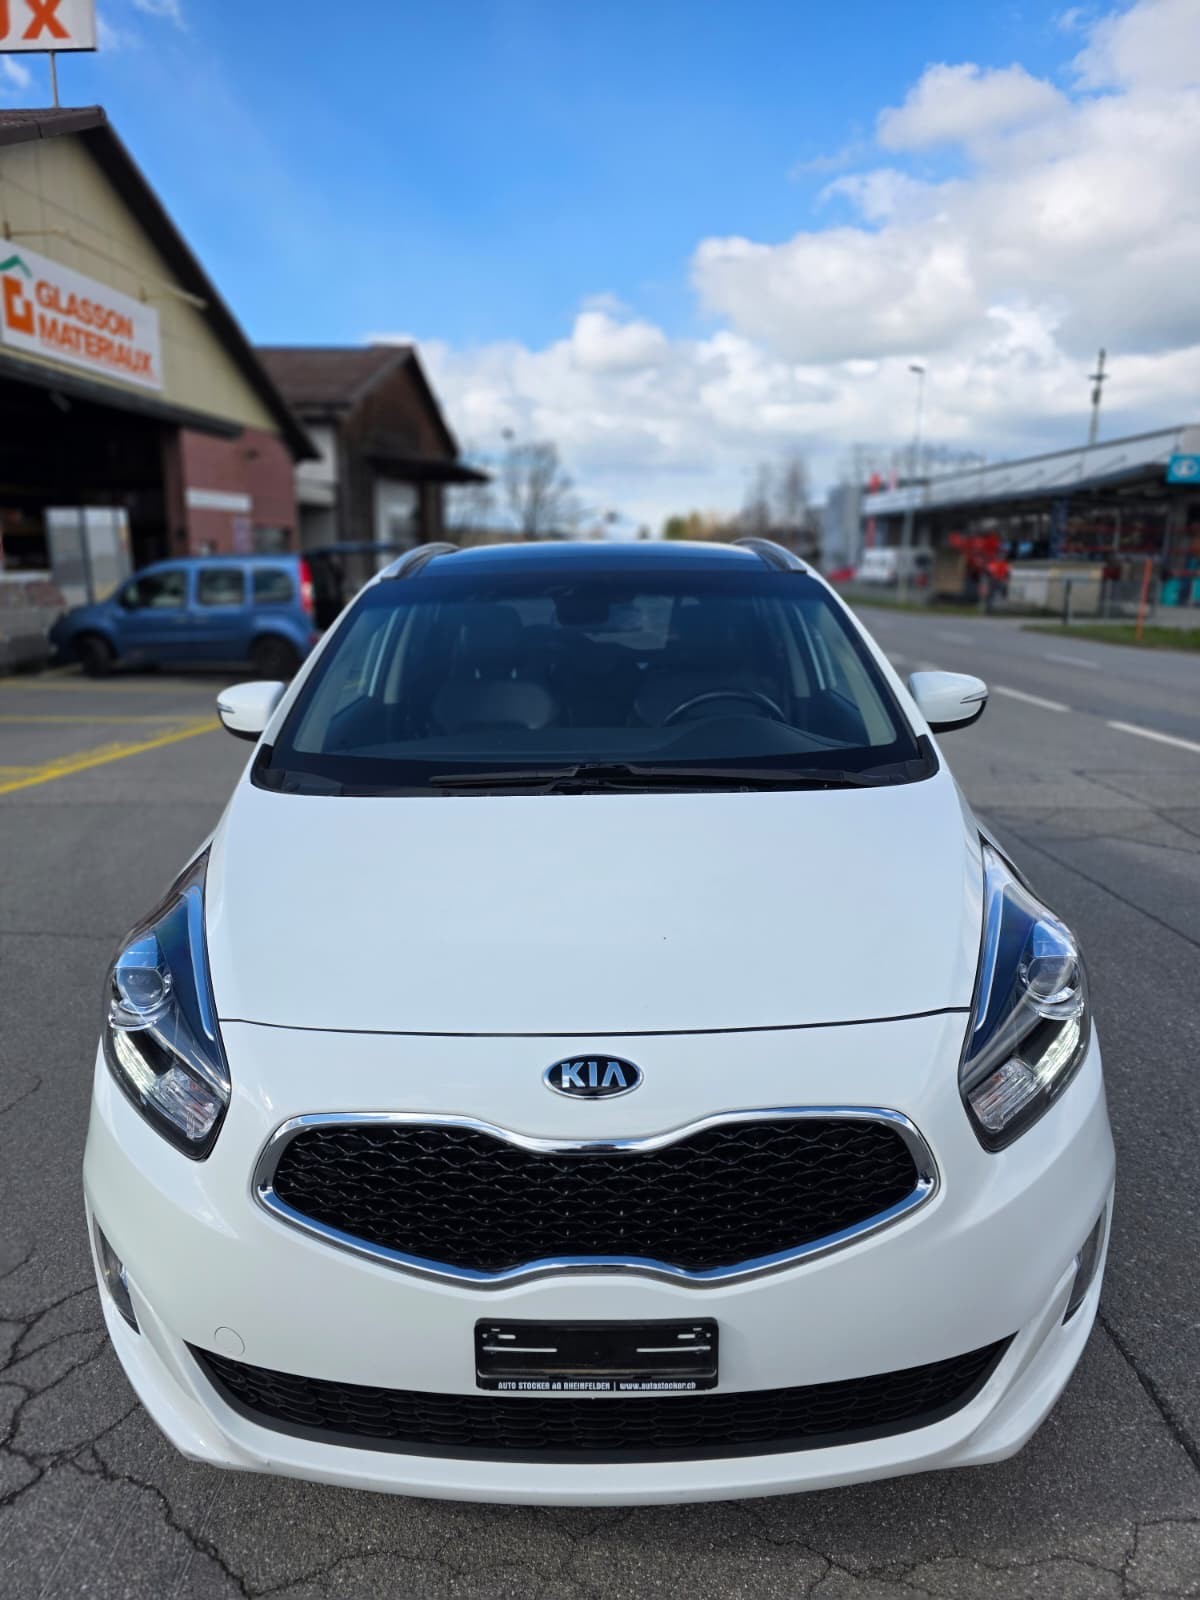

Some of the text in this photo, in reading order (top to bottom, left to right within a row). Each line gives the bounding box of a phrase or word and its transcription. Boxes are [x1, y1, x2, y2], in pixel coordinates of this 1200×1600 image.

[35, 280, 134, 340] GLASSON
[38, 313, 153, 374] MATERIAUX
[561, 1062, 627, 1088] KIA
[498, 1382, 516, 1390] AUTO
[518, 1382, 550, 1390] STOCKER
[563, 1382, 610, 1390] RHEINFELDEN
[620, 1382, 696, 1390] www.autostocker.ch
